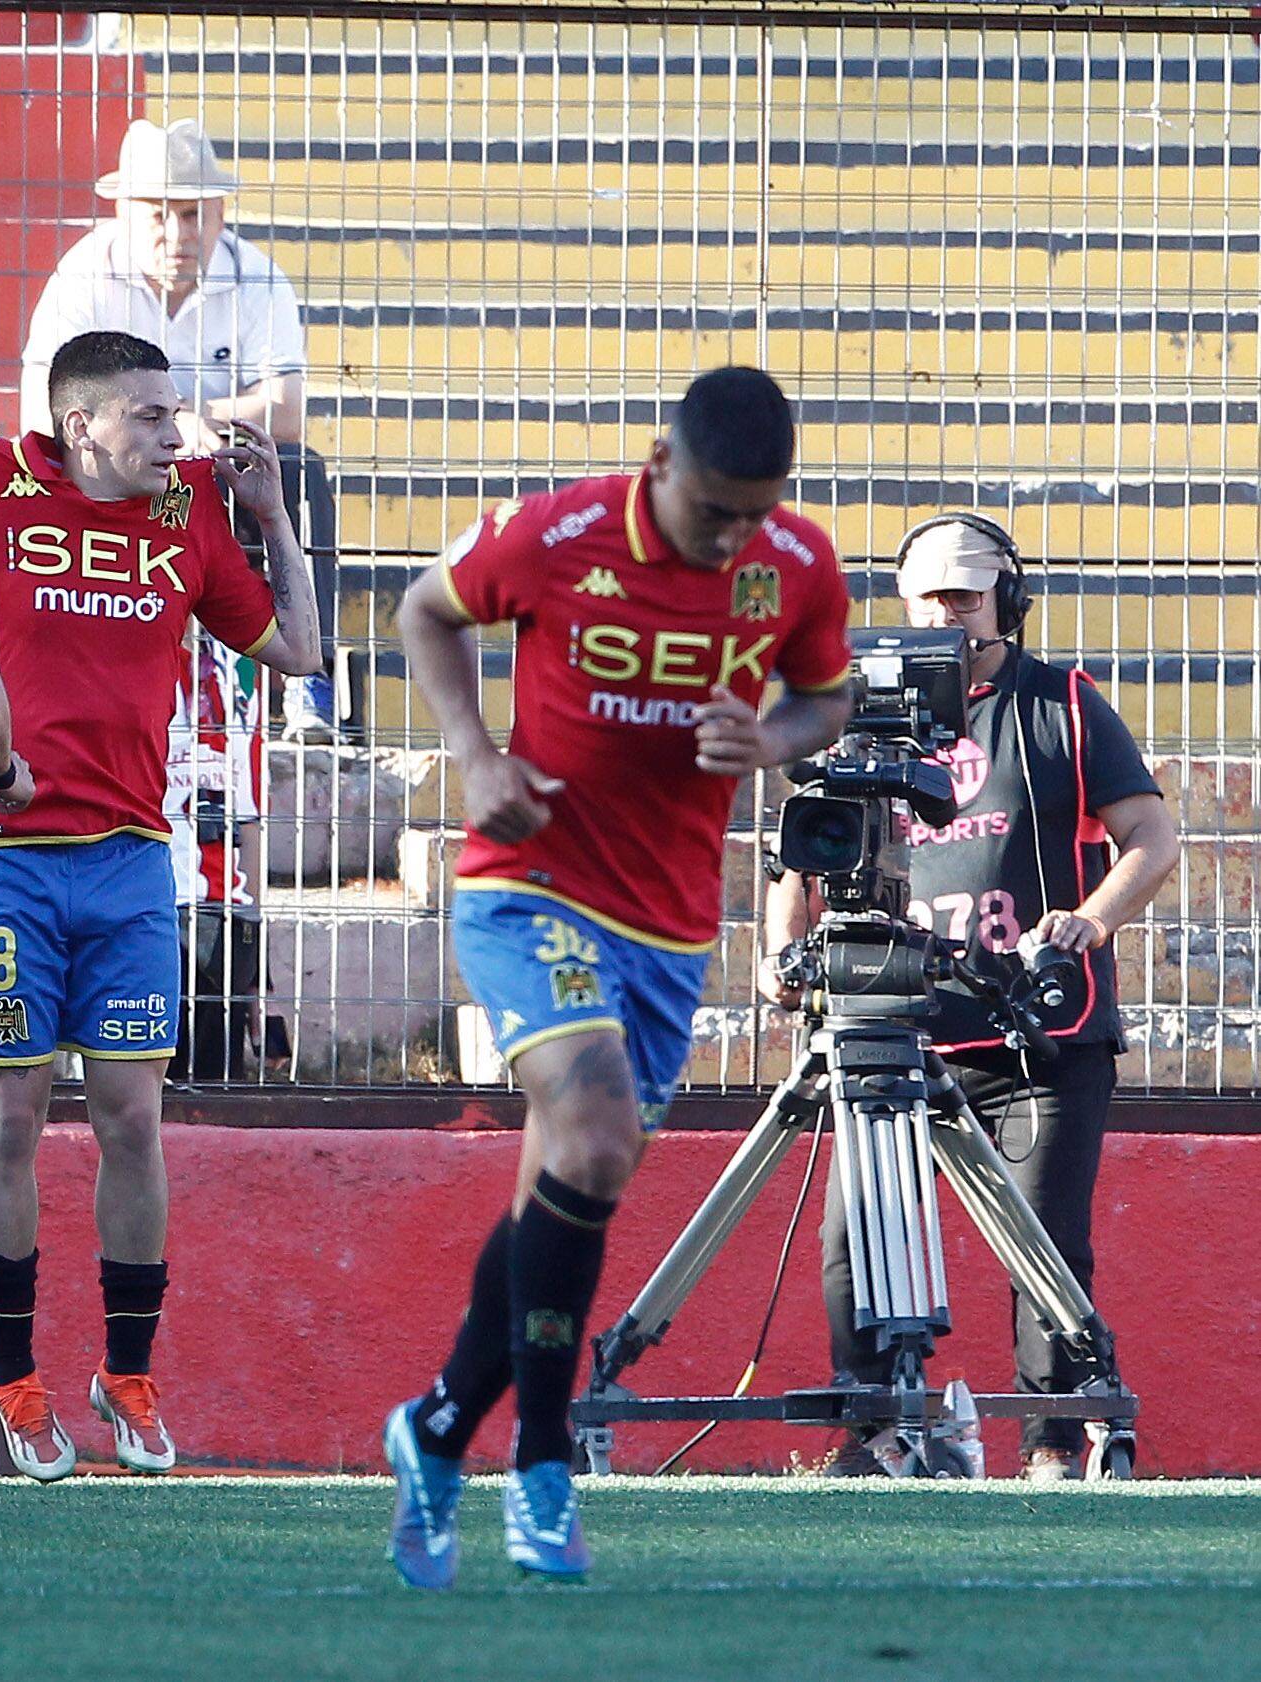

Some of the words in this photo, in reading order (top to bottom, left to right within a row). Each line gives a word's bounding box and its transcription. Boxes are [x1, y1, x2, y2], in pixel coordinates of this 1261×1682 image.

[17, 525, 187, 593] SEK
[580, 624, 776, 688] SEK
[107, 998, 146, 1009] smart
[147, 993, 167, 1014] fit
[103, 1019, 169, 1040] SEK
